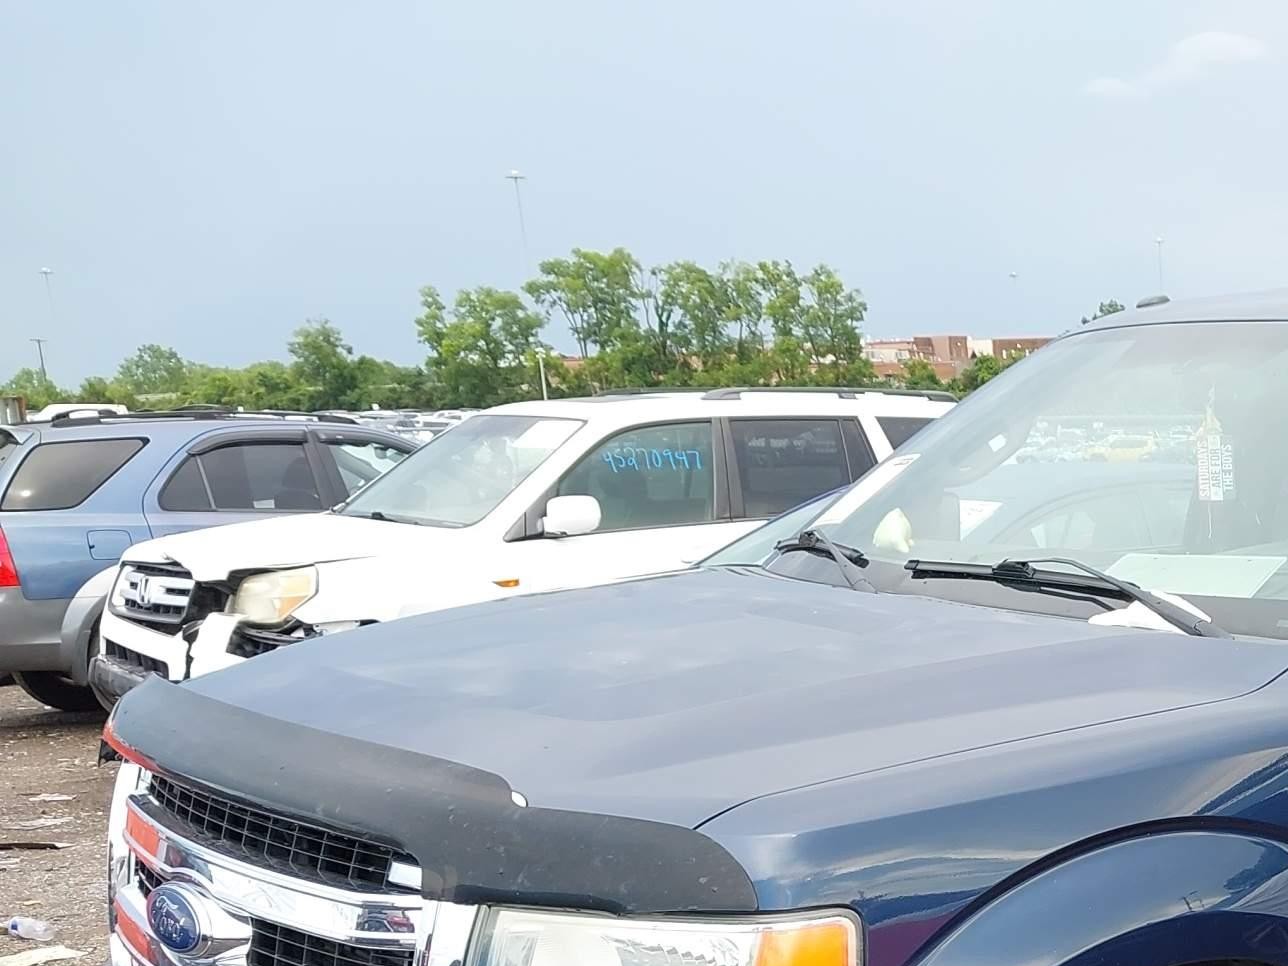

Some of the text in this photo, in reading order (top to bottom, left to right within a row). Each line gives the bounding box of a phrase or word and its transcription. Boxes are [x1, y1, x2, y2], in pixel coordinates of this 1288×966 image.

[602, 447, 702, 473] 45270947
[1209, 448, 1221, 488] ARE FOR
[1222, 444, 1233, 492] THE BOYS
